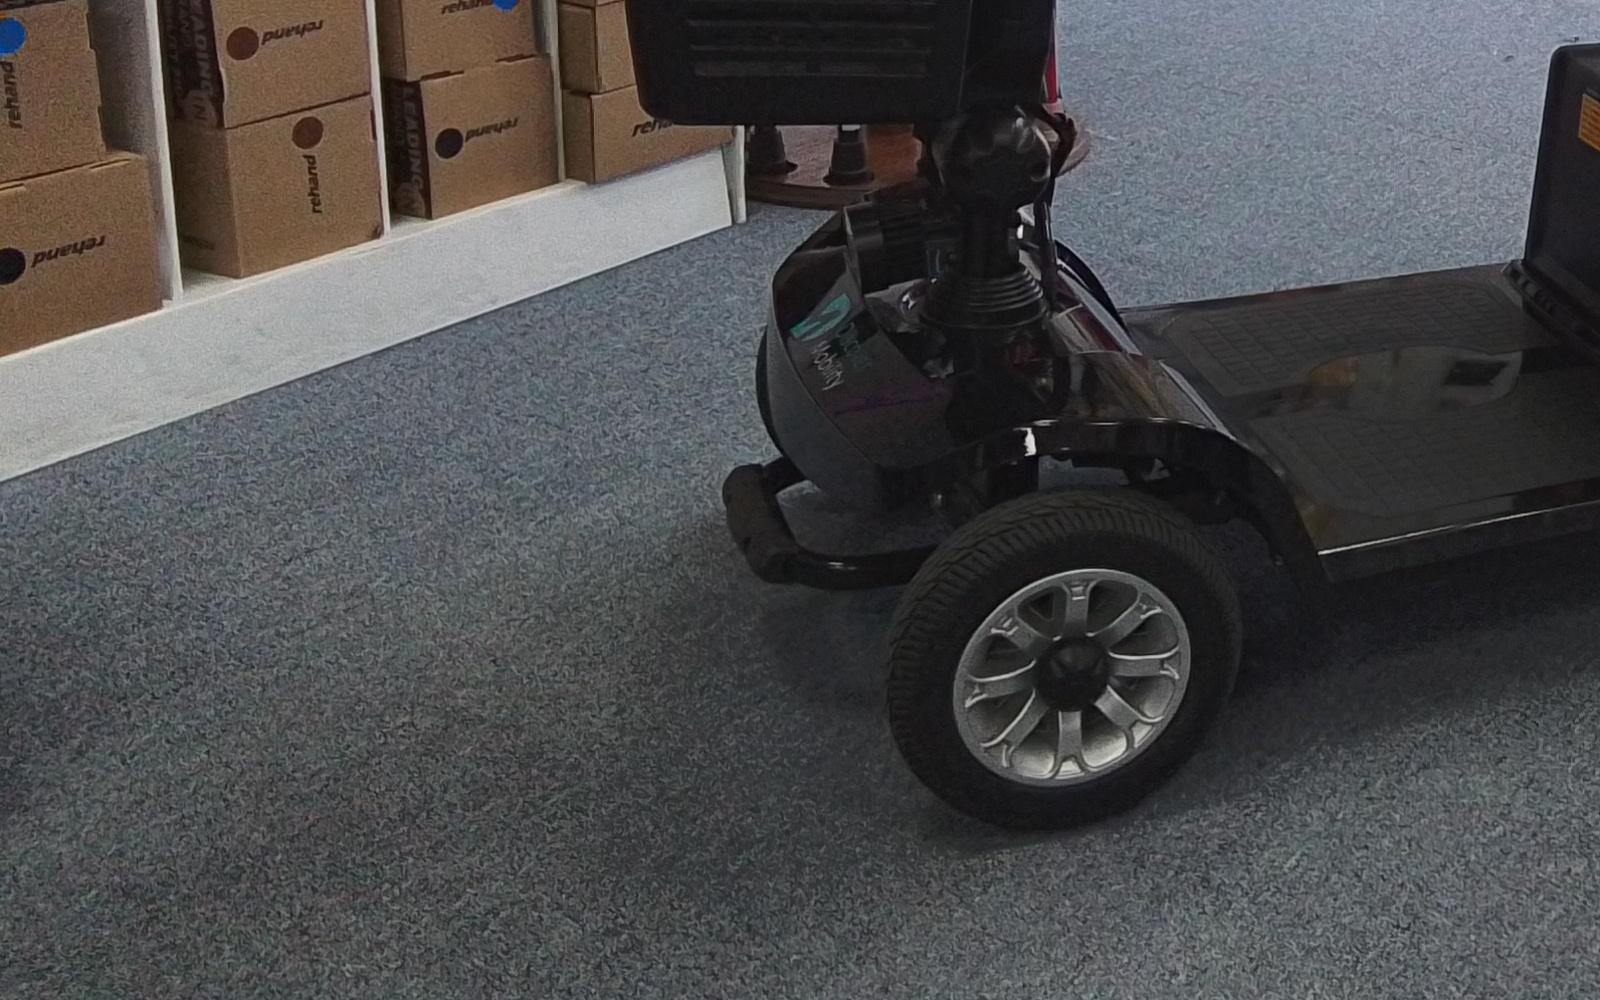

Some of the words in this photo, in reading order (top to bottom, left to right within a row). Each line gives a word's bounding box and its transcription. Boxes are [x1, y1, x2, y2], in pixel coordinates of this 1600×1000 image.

[261, 20, 324, 46] rehand
[0, 60, 23, 130] rehand
[465, 117, 519, 142] rehand
[302, 154, 323, 214] rehand
[31, 235, 106, 268] rehand
